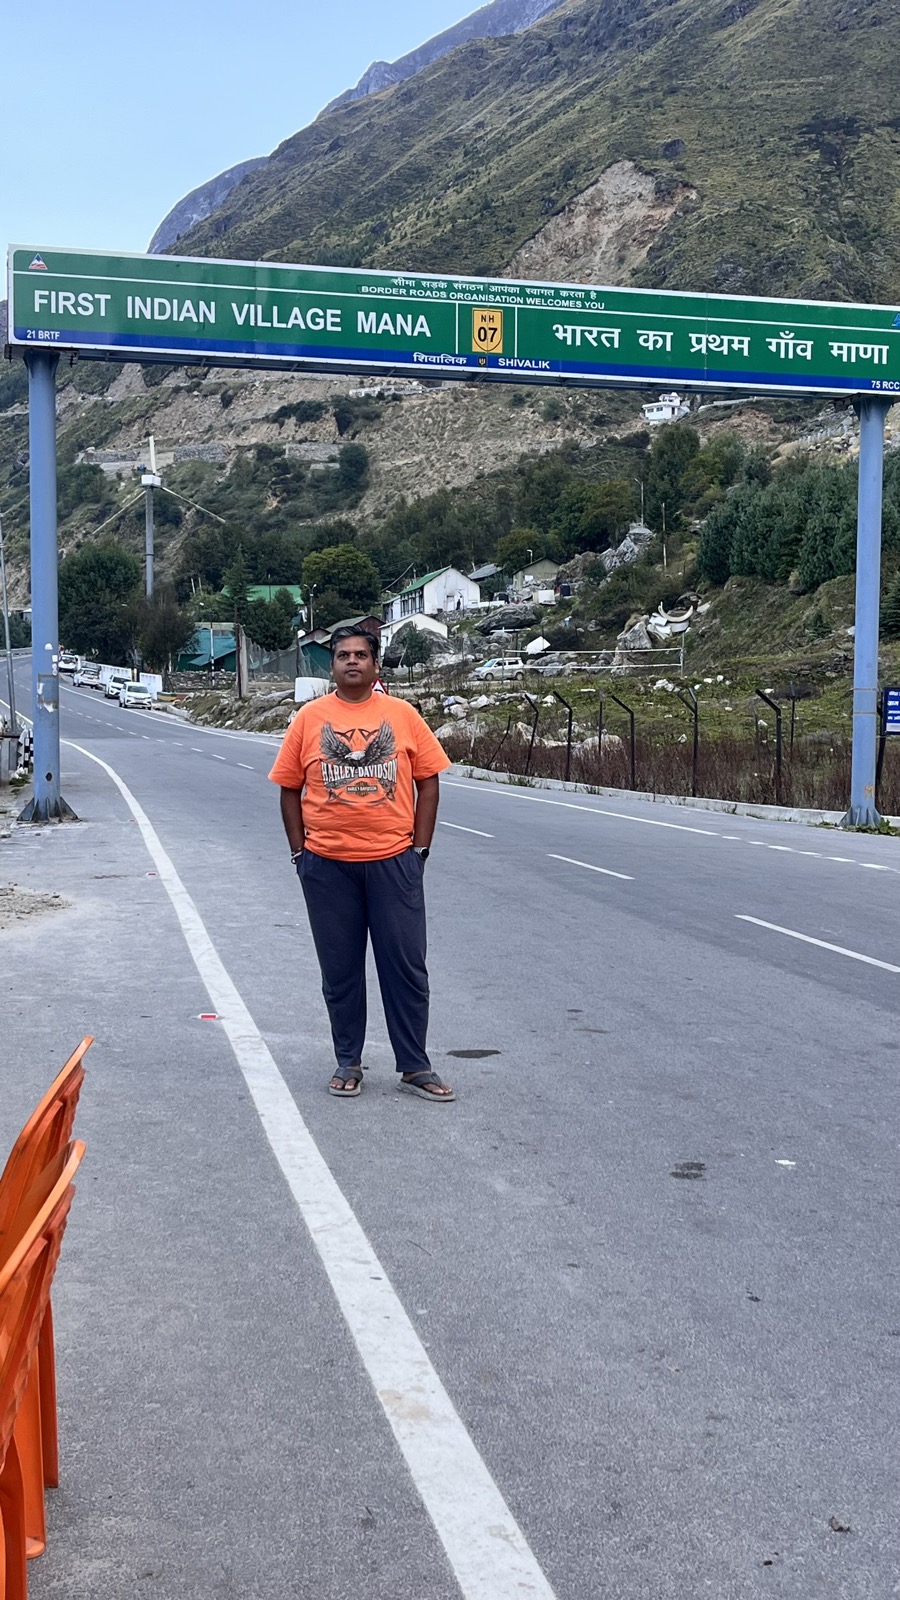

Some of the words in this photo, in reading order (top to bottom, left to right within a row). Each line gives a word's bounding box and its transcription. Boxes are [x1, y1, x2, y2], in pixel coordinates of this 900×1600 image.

[391, 278, 415, 286] सीमा
[560, 290, 585, 298] करता
[590, 290, 597, 300] है
[361, 285, 406, 296] BORDER
[410, 289, 446, 298] ROADS
[449, 292, 524, 304] ORGANISATION
[526, 297, 582, 308] WELCOMES
[584, 301, 604, 310] YOU
[34, 290, 111, 316] FIRST
[127, 296, 216, 324] INDIAN
[231, 303, 342, 332] VILLAGE
[357, 312, 431, 337] MANA
[26, 330, 36, 339] 21
[38, 330, 60, 340] BRTF
[478, 326, 498, 342] 07
[552, 324, 621, 348] भारत
[636, 330, 673, 351] का
[689, 333, 750, 356] प्रथम
[766, 330, 814, 360] गाँव
[828, 342, 889, 364] माणा
[413, 352, 467, 365] शिवालिक
[498, 358, 550, 369] SHIVALIK
[871, 380, 880, 388] 75
[882, 381, 900, 390] RCC
